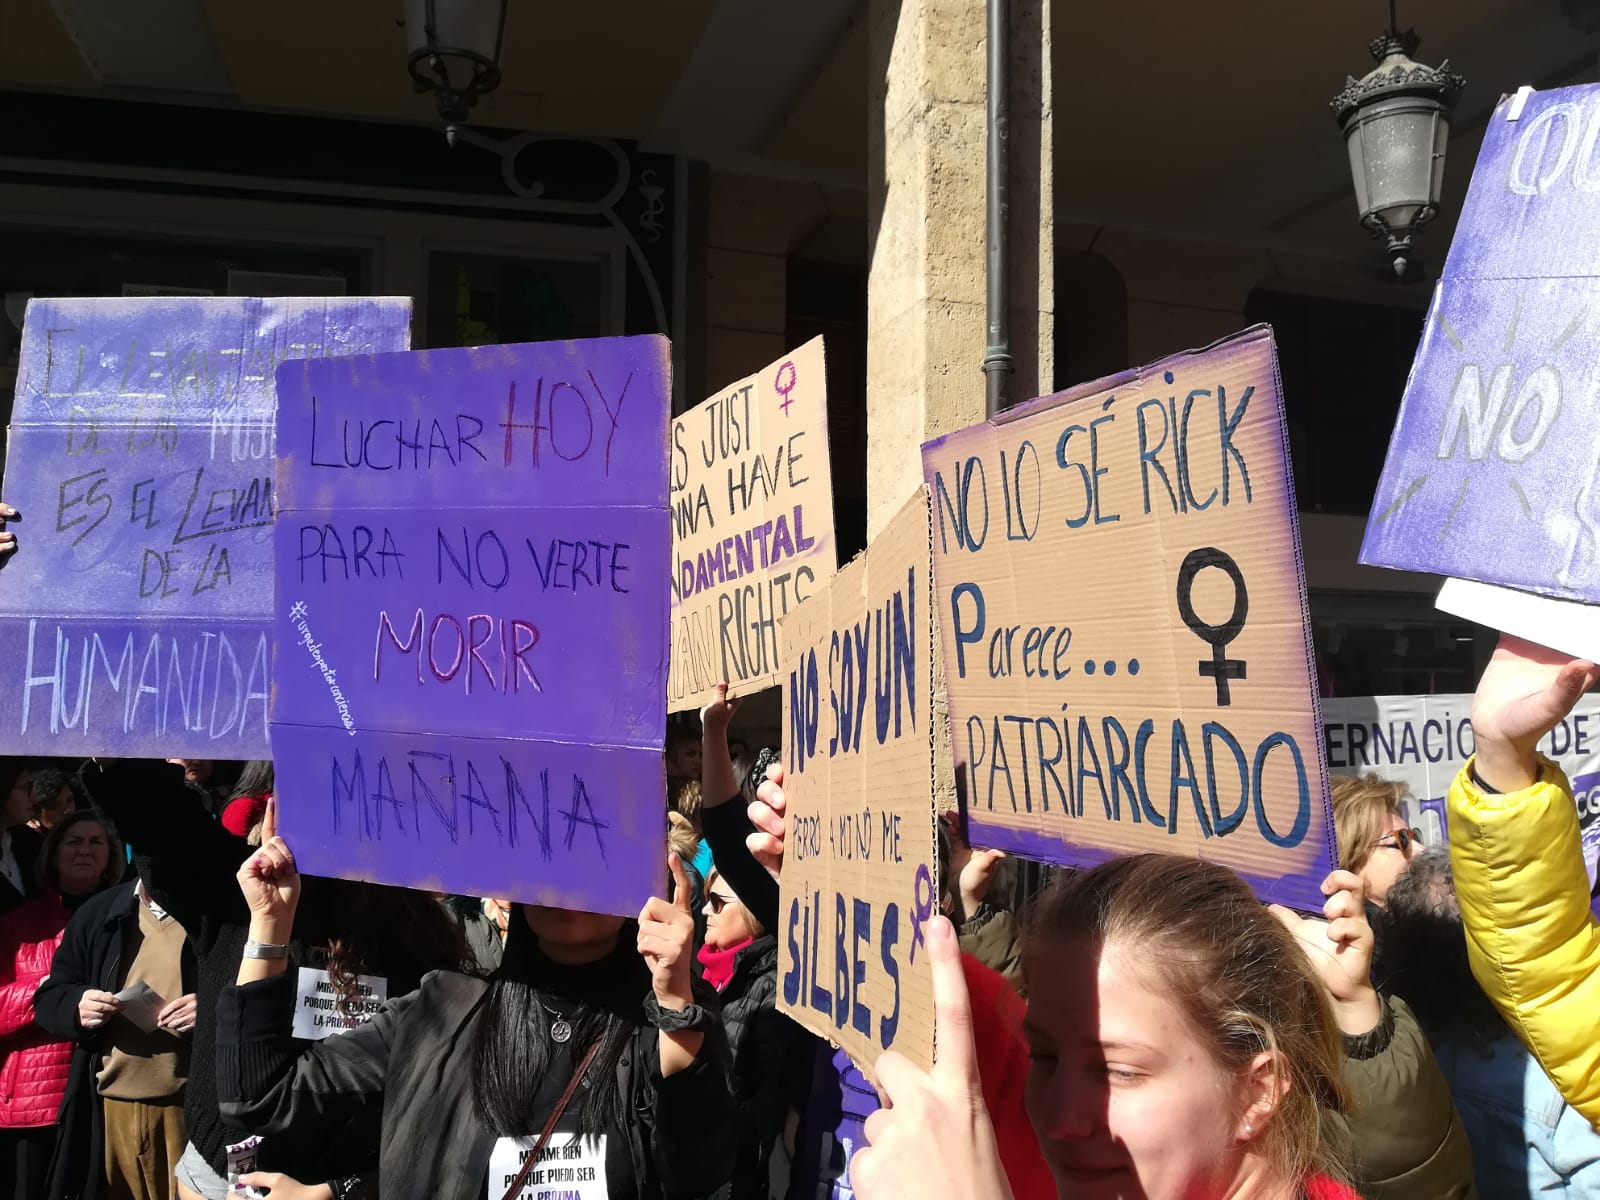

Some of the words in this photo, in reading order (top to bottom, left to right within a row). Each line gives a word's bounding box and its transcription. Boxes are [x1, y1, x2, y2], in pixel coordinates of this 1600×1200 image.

[66, 404, 117, 457] DE
[310, 396, 488, 471] LUCHAR
[498, 369, 635, 477] HOY
[671, 420, 689, 494] S
[701, 384, 754, 469] JUST
[1436, 363, 1562, 464] NO
[55, 467, 112, 547] ES
[129, 478, 156, 530] EL
[727, 431, 810, 517] HAVE
[934, 455, 988, 556] NO
[999, 440, 1042, 542] LO
[1055, 396, 1121, 529] SÉ
[138, 548, 183, 600] DE
[191, 542, 233, 597] LA
[296, 522, 406, 585] PARA
[436, 526, 510, 591] NO
[525, 537, 631, 594] VERTE
[20, 618, 272, 743] HUMANIDA
[373, 606, 545, 696] MORIR
[790, 646, 819, 775] NO
[829, 609, 871, 759] SOY
[874, 565, 916, 746] UN
[1550, 714, 1592, 757] DE
[332, 747, 610, 869] MAÑANA
[829, 815, 836, 861] A
[839, 814, 852, 861] MI
[881, 810, 903, 864] ME
[313, 1014, 324, 1026] LA
[547, 1167, 575, 1183] PUEDO
[576, 1166, 596, 1182] SER
[562, 1145, 582, 1160] BIEN
